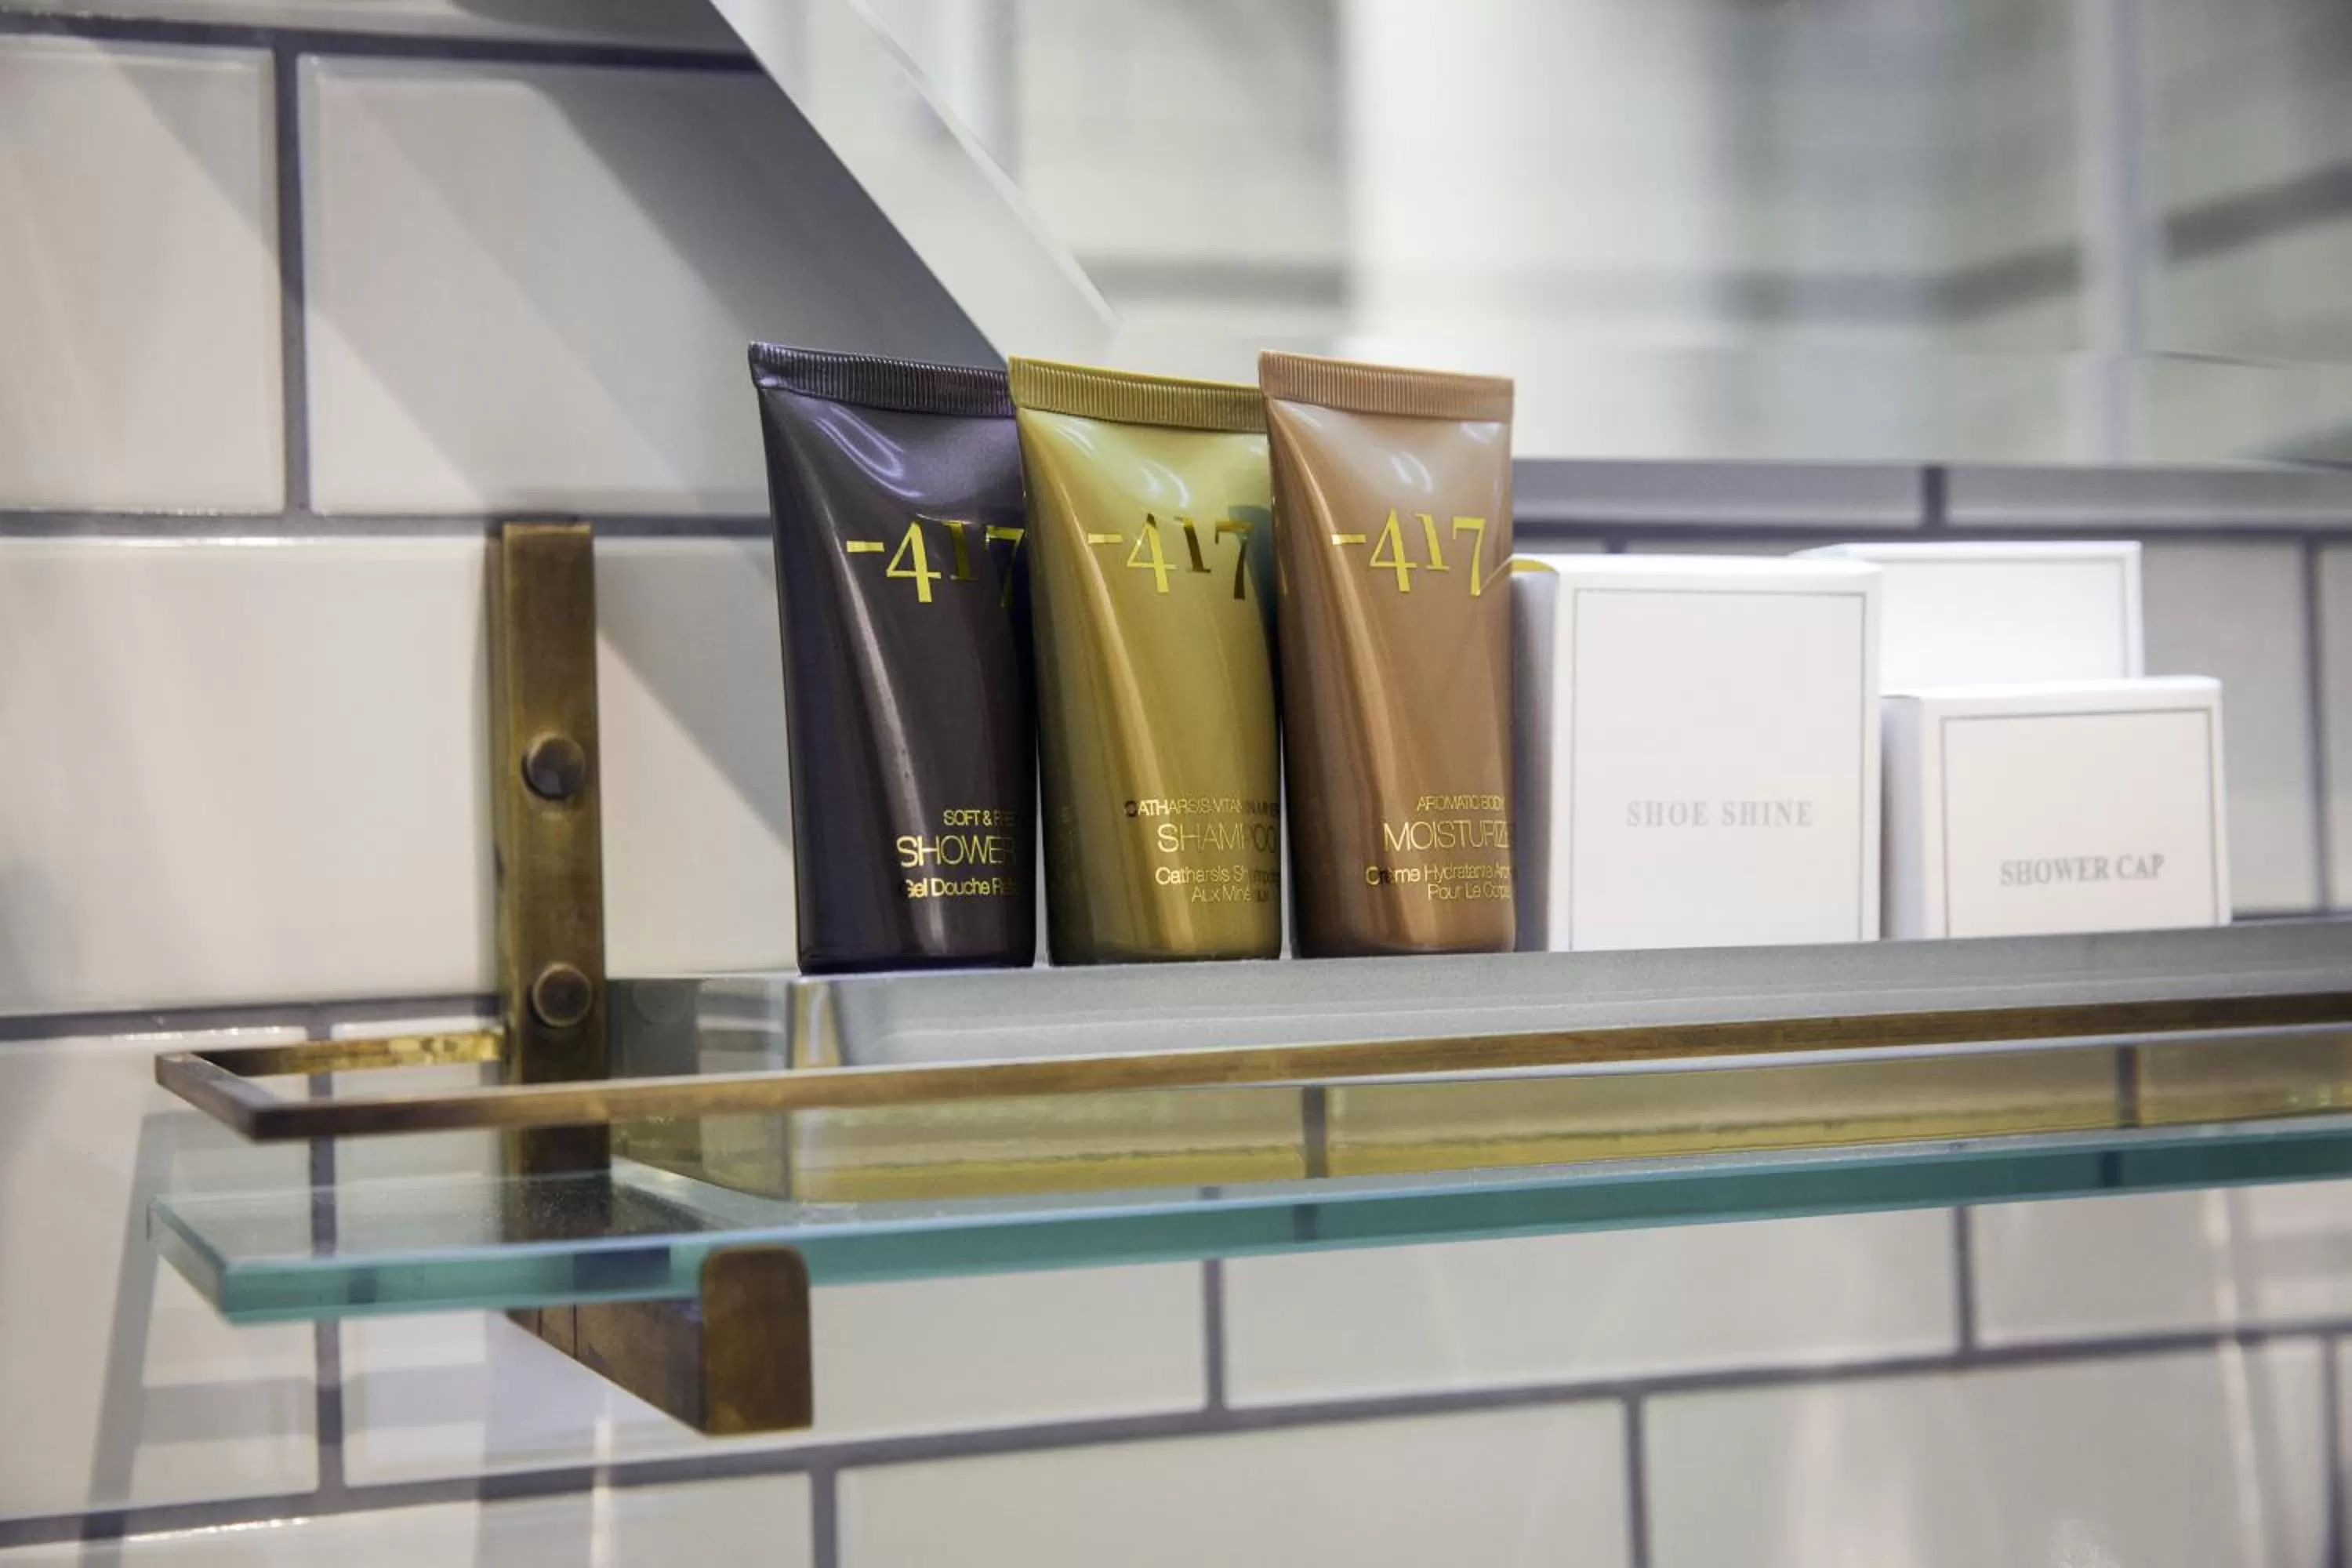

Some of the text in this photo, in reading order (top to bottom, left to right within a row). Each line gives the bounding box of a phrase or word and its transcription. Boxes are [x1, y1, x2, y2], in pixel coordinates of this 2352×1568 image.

[847, 520, 1025, 607] -417
[1087, 512, 1253, 601] -417
[1330, 508, 1486, 597] -417
[943, 809, 980, 826] SOFT
[982, 809, 992, 826] &
[1626, 798, 1813, 828] SHOE SHINE
[2000, 852, 2165, 886] SHOWER CAP
[931, 877, 991, 898] Douche
[1428, 882, 1464, 901] Pour
[1465, 881, 1481, 899] Le
